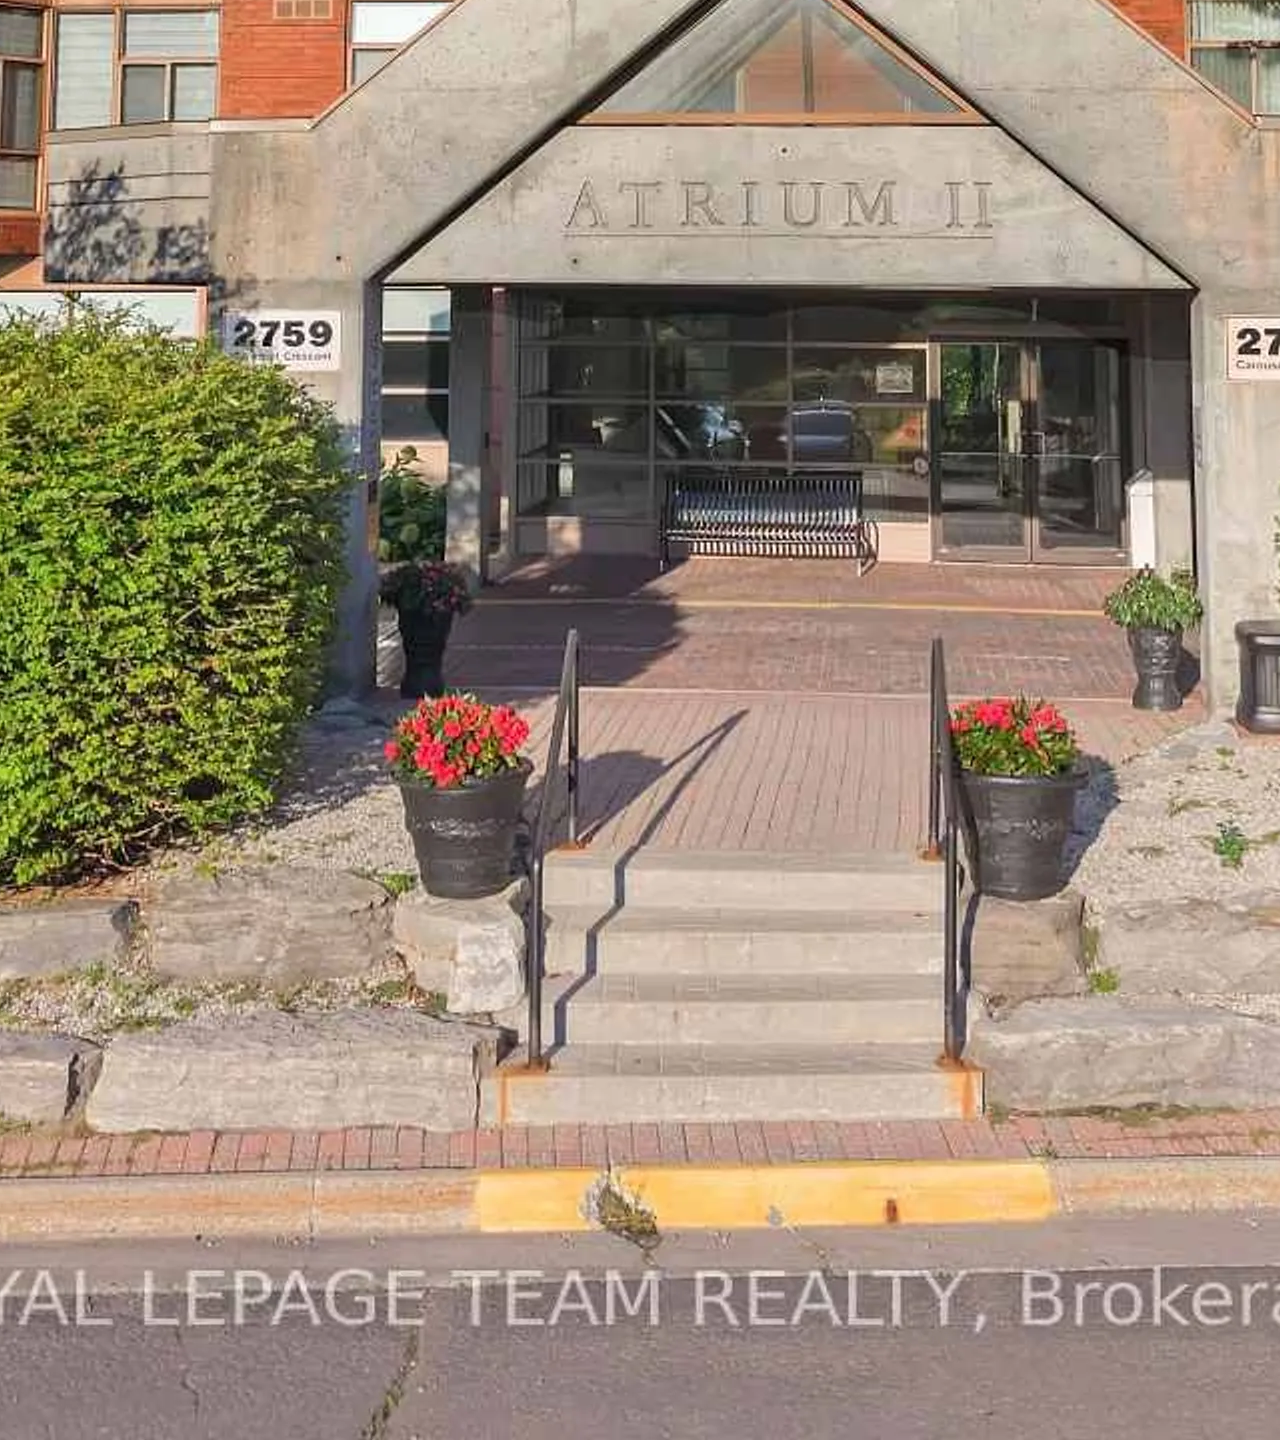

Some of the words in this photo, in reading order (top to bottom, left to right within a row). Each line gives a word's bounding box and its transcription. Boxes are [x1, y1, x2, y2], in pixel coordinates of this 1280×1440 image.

[563, 177, 897, 228] ATRIUM
[944, 181, 994, 228] II
[234, 320, 333, 347] 2759
